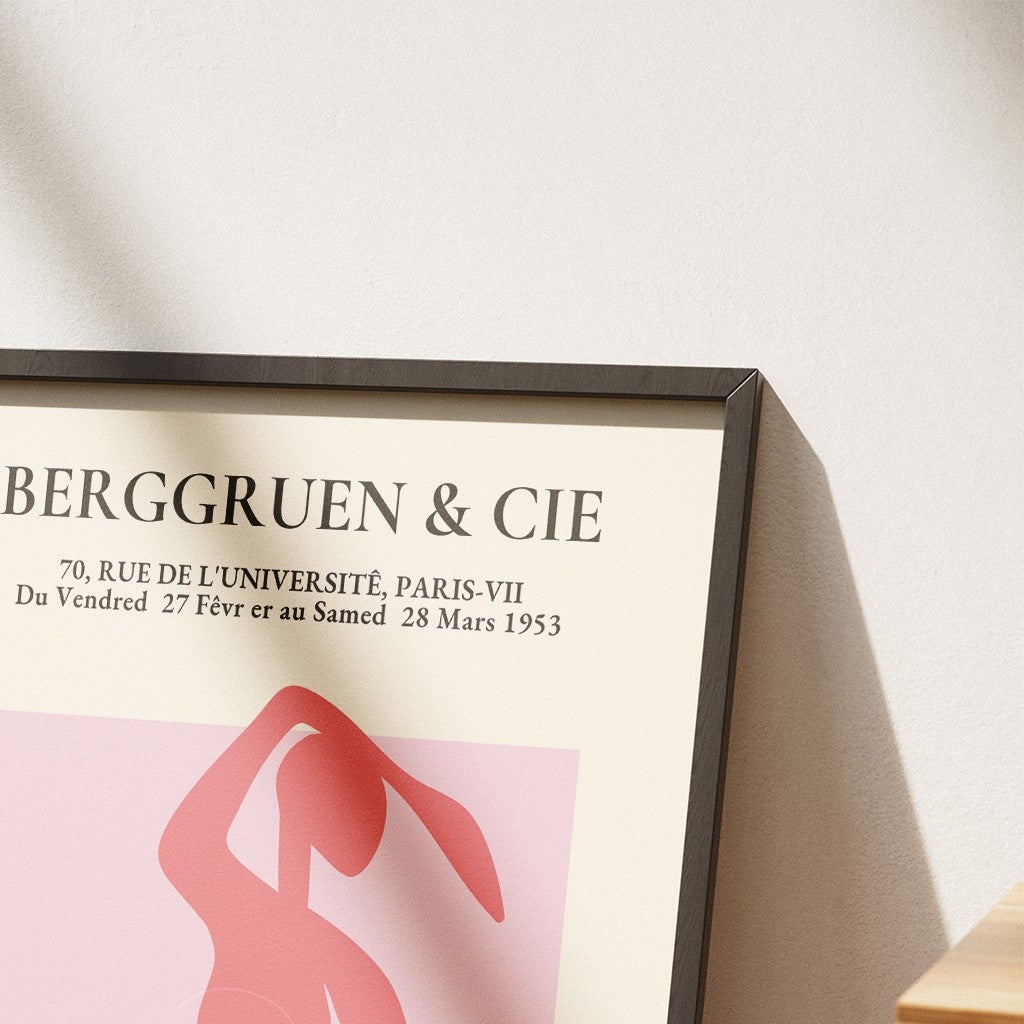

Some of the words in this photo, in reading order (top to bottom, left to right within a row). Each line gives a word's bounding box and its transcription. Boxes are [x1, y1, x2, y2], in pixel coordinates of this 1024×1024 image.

[0, 465, 408, 535] BERGGRUEN
[424, 482, 473, 537] &
[493, 486, 603, 543] CIE
[59, 558, 91, 585] 70,
[97, 559, 151, 584] RUE
[156, 562, 193, 586] DE
[394, 575, 525, 605] PARIS-VII
[14, 583, 48, 607] Du
[55, 585, 148, 613] Vendred
[161, 592, 191, 615] 27
[279, 606, 306, 622] au
[312, 600, 387, 626] Samed
[400, 606, 429, 629] 28
[435, 607, 496, 634] Mars
[504, 611, 562, 637] 1953
